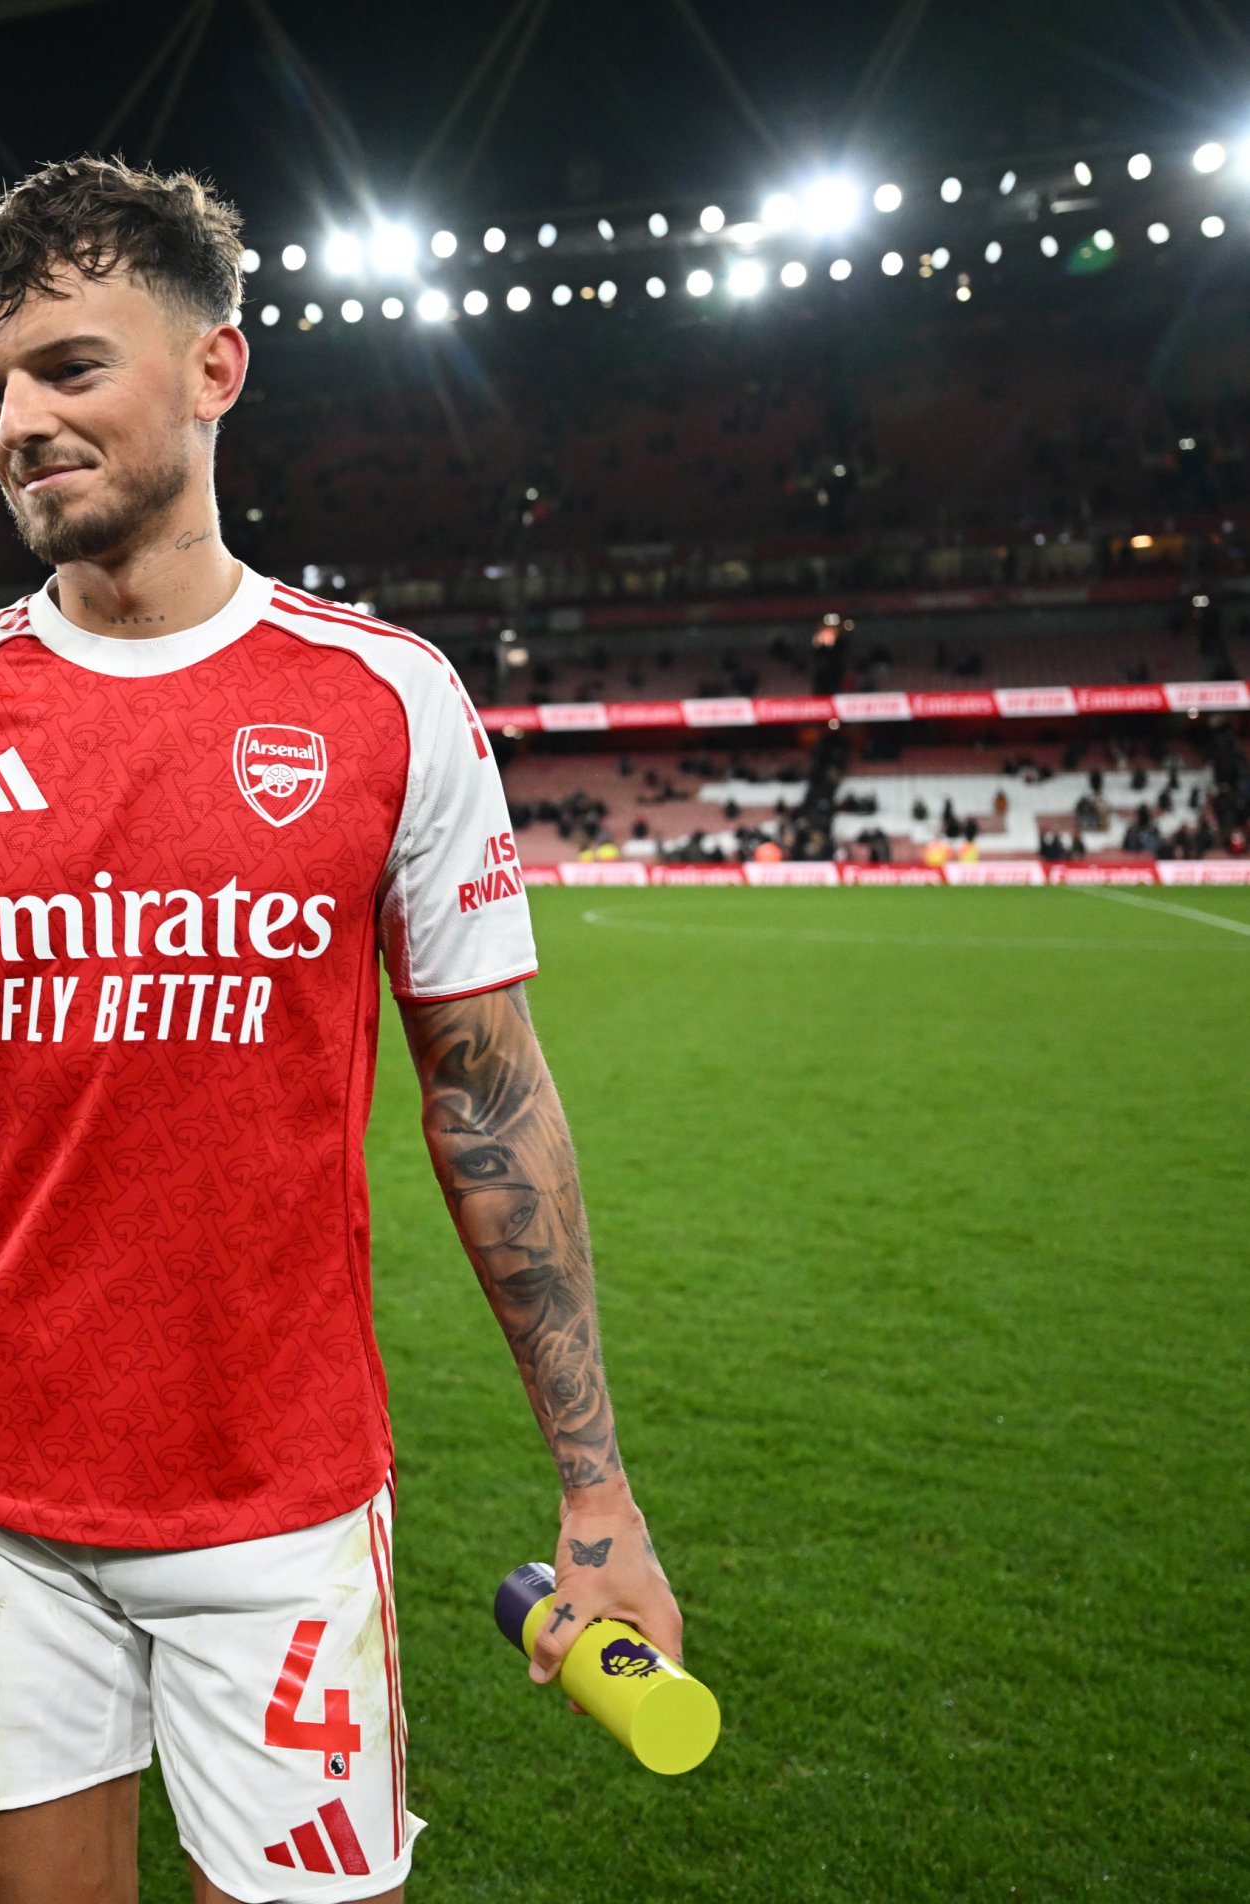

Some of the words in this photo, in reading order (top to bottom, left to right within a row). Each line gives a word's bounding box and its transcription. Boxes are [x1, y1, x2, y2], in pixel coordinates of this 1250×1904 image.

[247, 739, 314, 760] Arsenal
[1, 976, 79, 1043] FLY
[93, 974, 272, 1043] BETTER
[264, 1620, 361, 1780] 4
